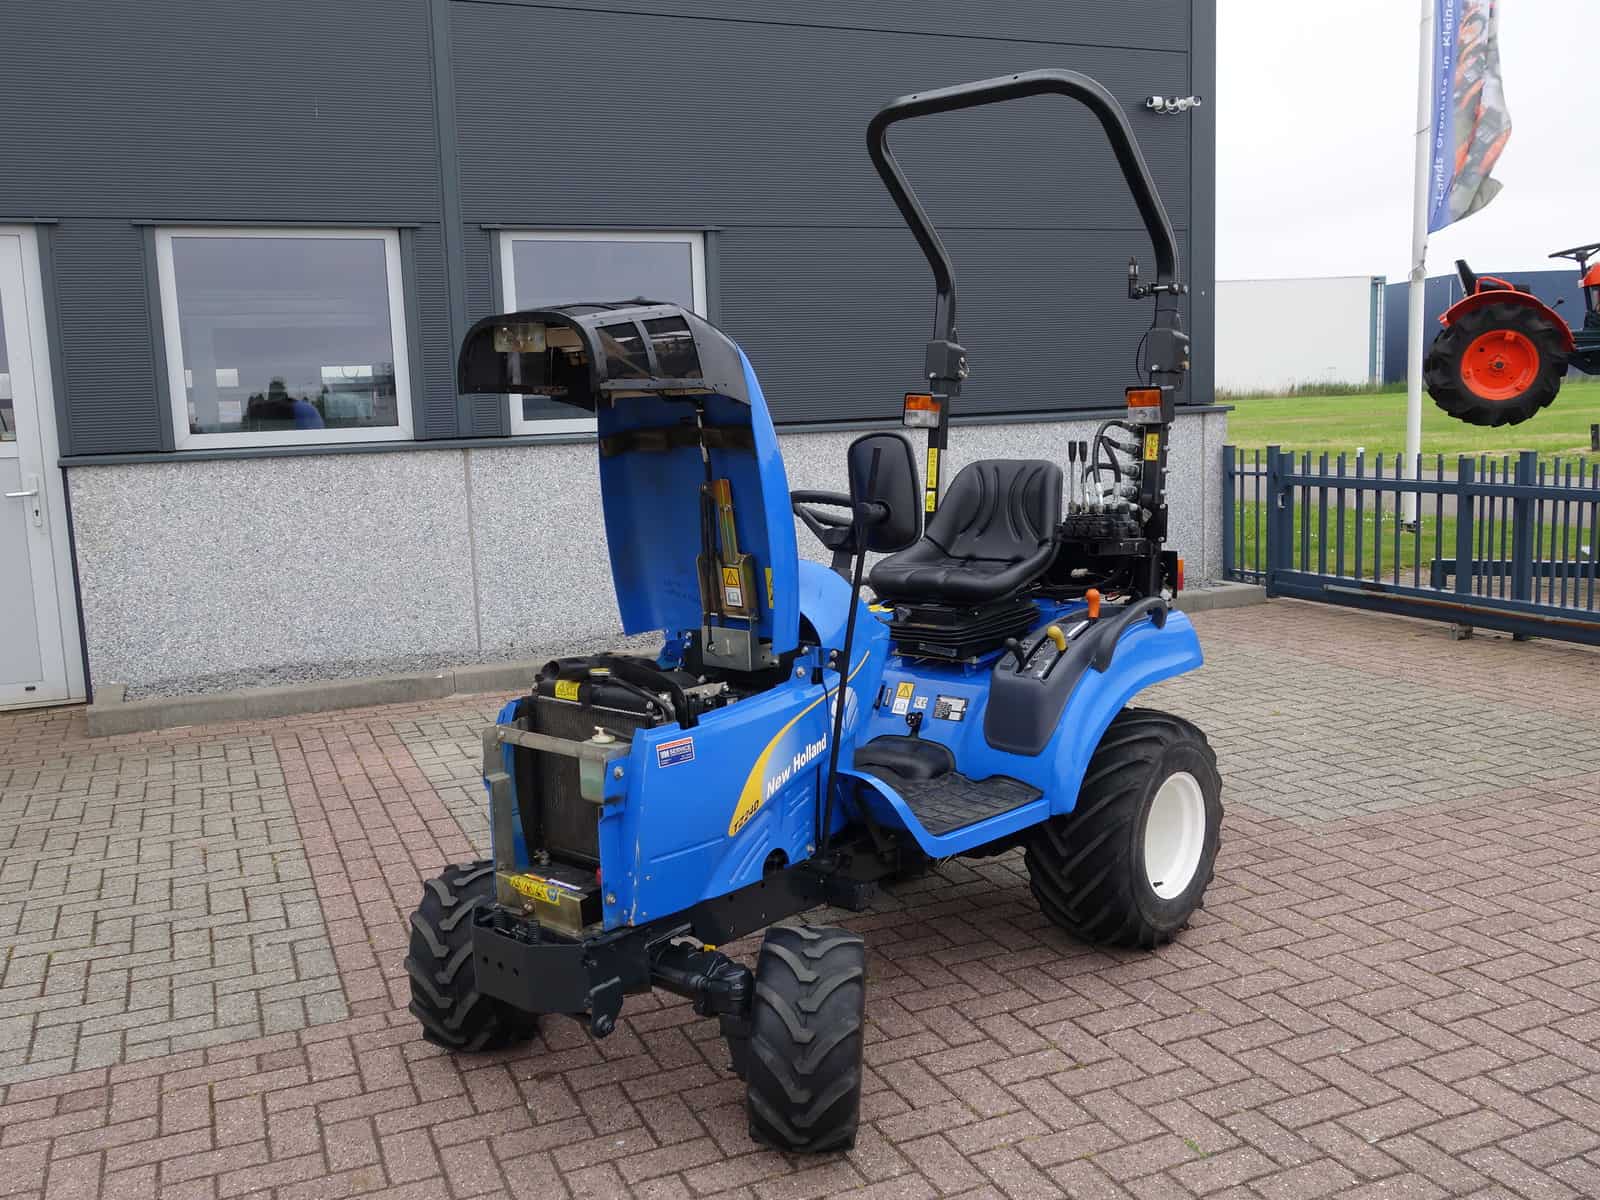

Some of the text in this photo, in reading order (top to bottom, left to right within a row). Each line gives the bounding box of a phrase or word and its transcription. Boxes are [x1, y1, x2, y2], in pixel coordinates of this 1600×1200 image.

[1442, 55, 1451, 70] in
[767, 732, 827, 800] New Holland
